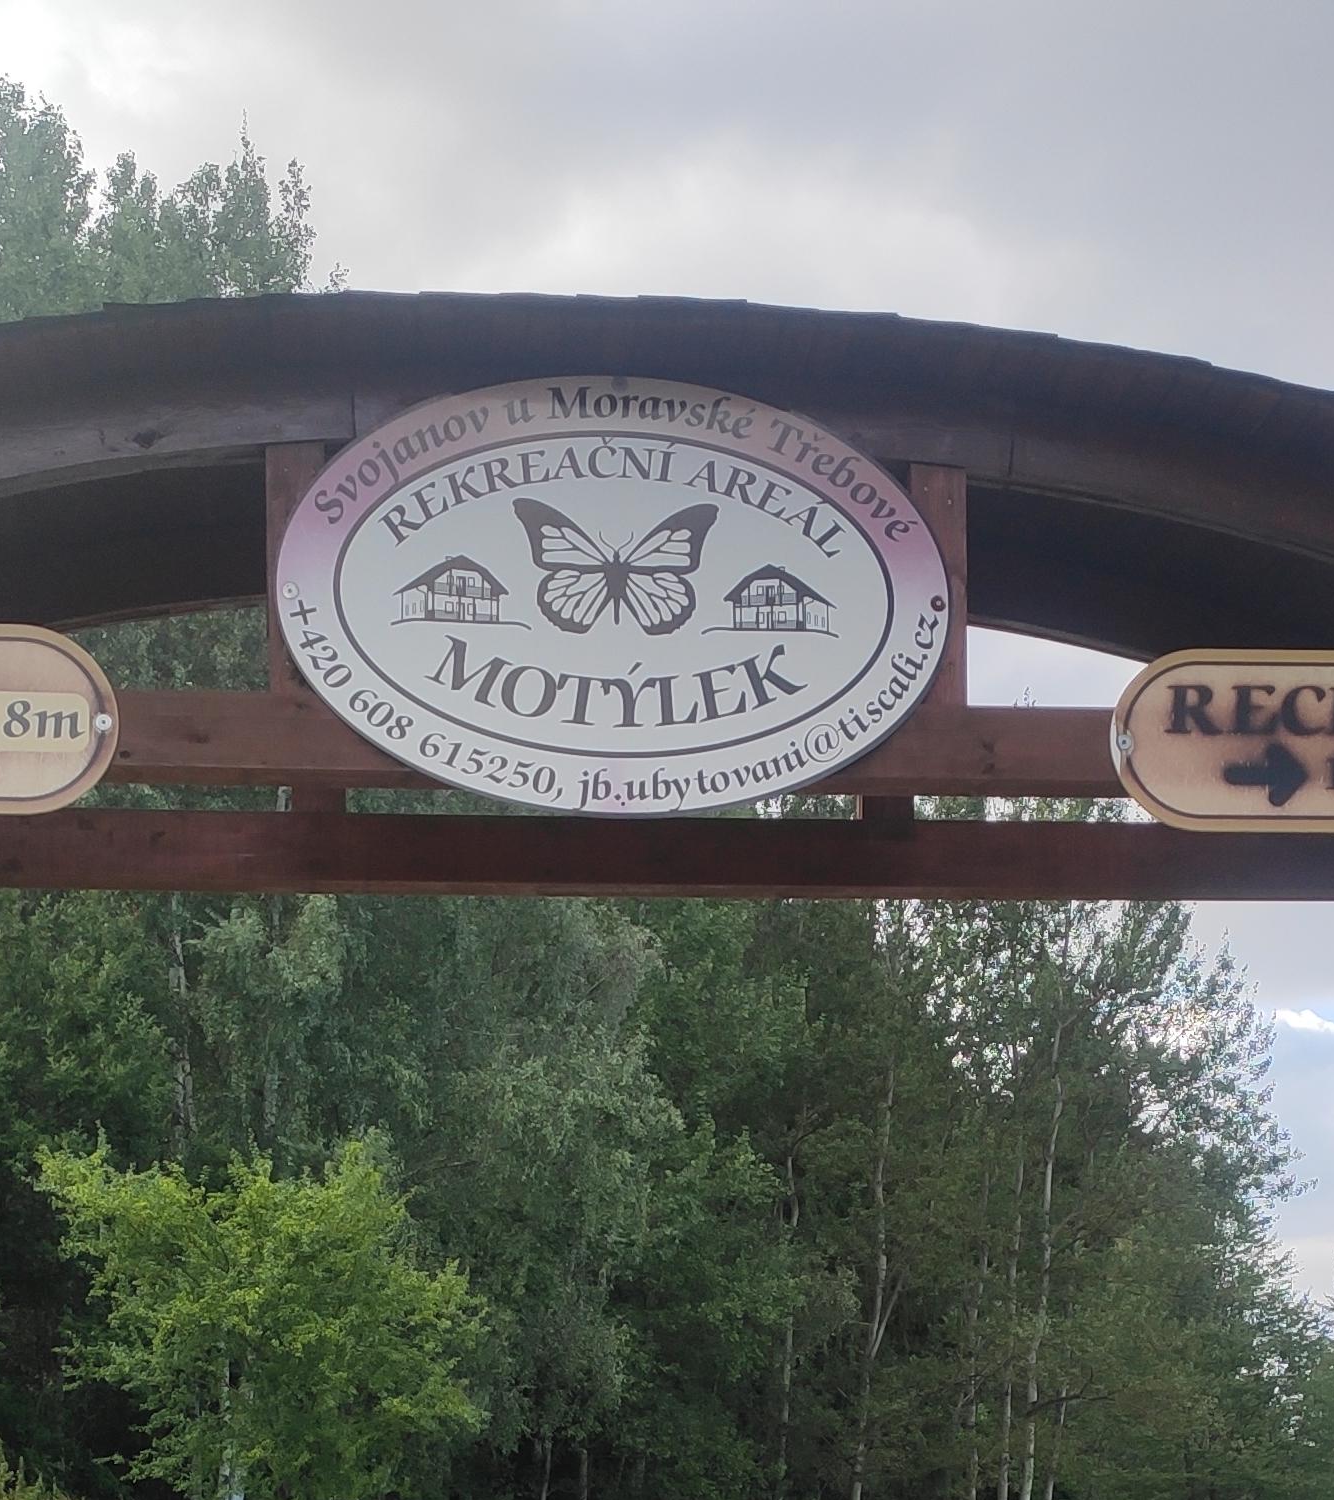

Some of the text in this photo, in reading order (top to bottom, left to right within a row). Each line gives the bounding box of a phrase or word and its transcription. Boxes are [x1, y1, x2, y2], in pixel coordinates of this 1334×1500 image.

[315, 386, 919, 543] Svojanov u Moravské Třebové
[378, 436, 847, 559] REKREAČNÍ AREÁL
[289, 599, 940, 811] +420 608 615250, jb.ubytovani@tiscali.cz
[424, 634, 809, 729] MOTÝLEK
